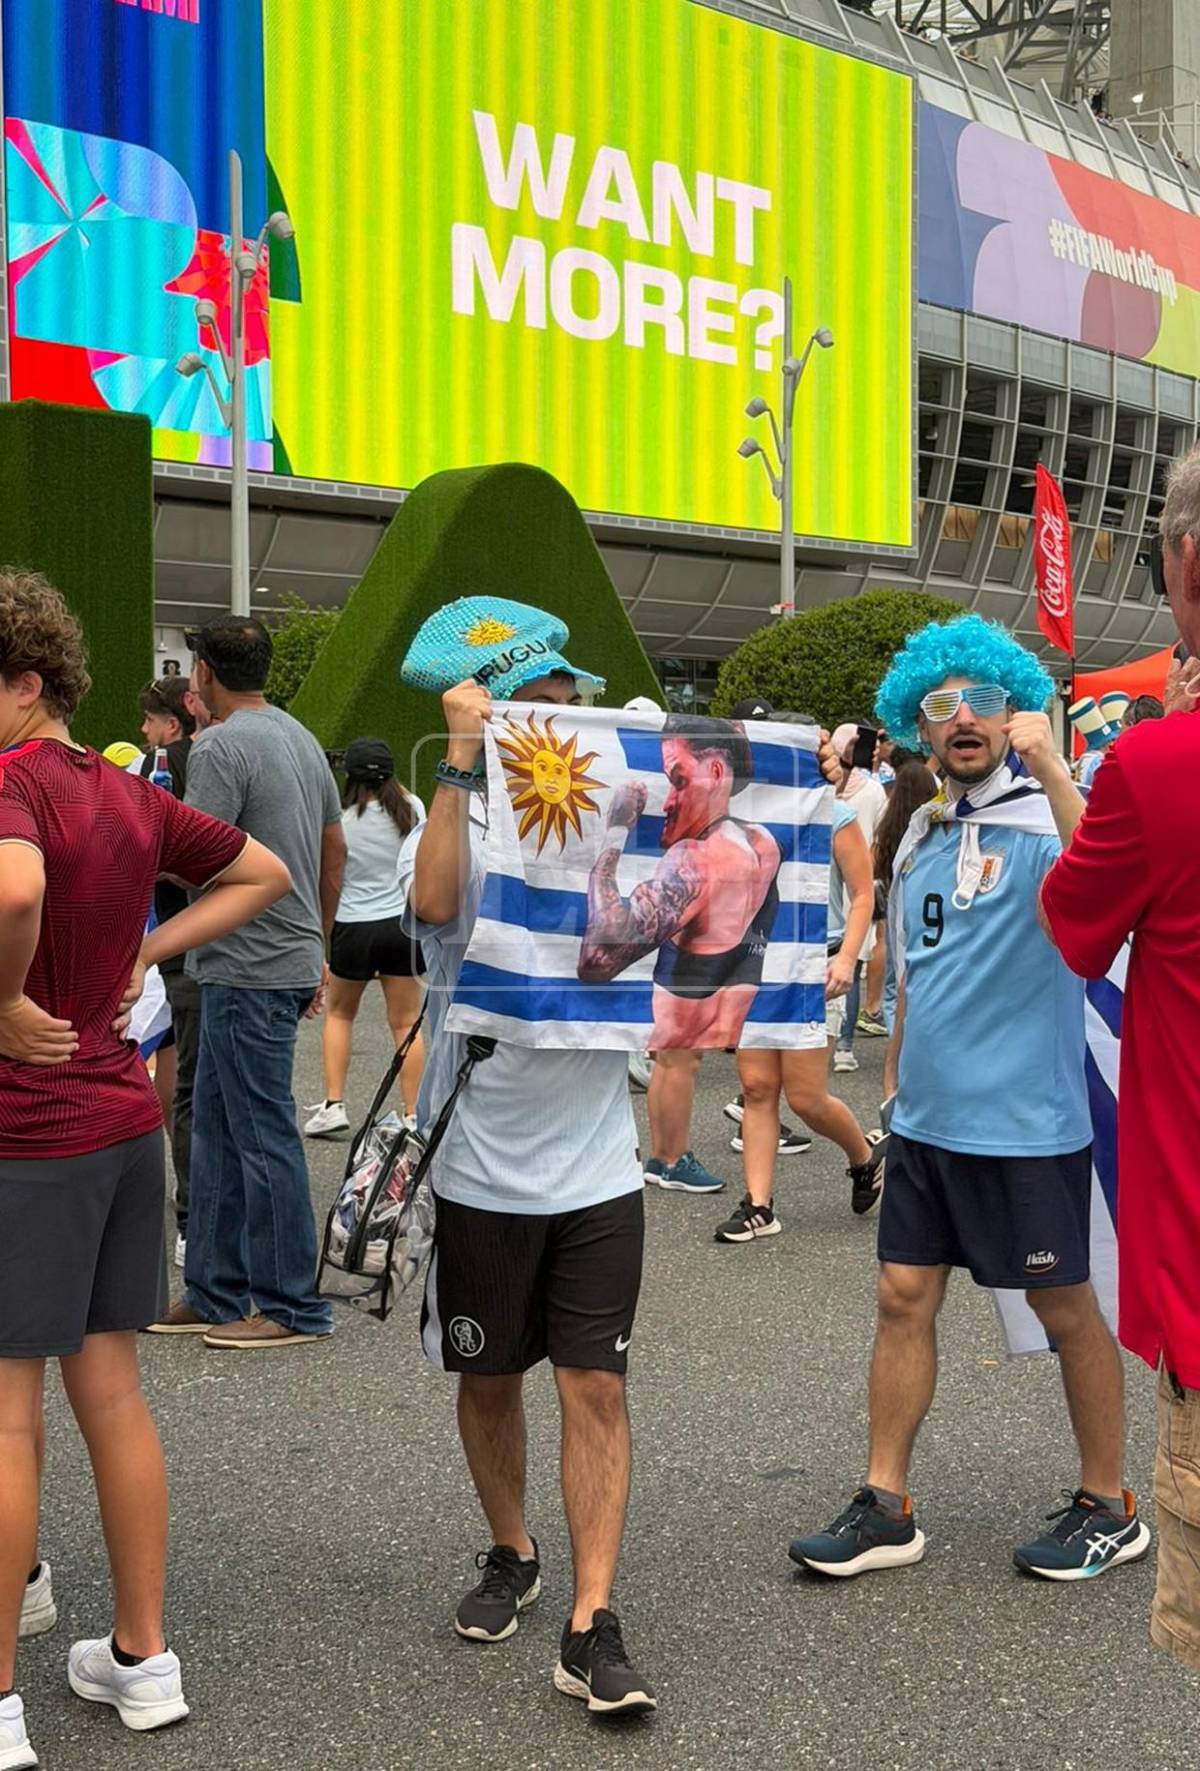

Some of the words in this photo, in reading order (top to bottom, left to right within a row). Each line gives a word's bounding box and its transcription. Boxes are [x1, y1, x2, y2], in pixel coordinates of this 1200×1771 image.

[472, 109, 772, 267] WANT
[452, 222, 785, 372] MORE?
[1048, 218, 1178, 306] #FIFAWorldCup
[472, 637, 553, 687] RUGU
[922, 892, 944, 948] 9
